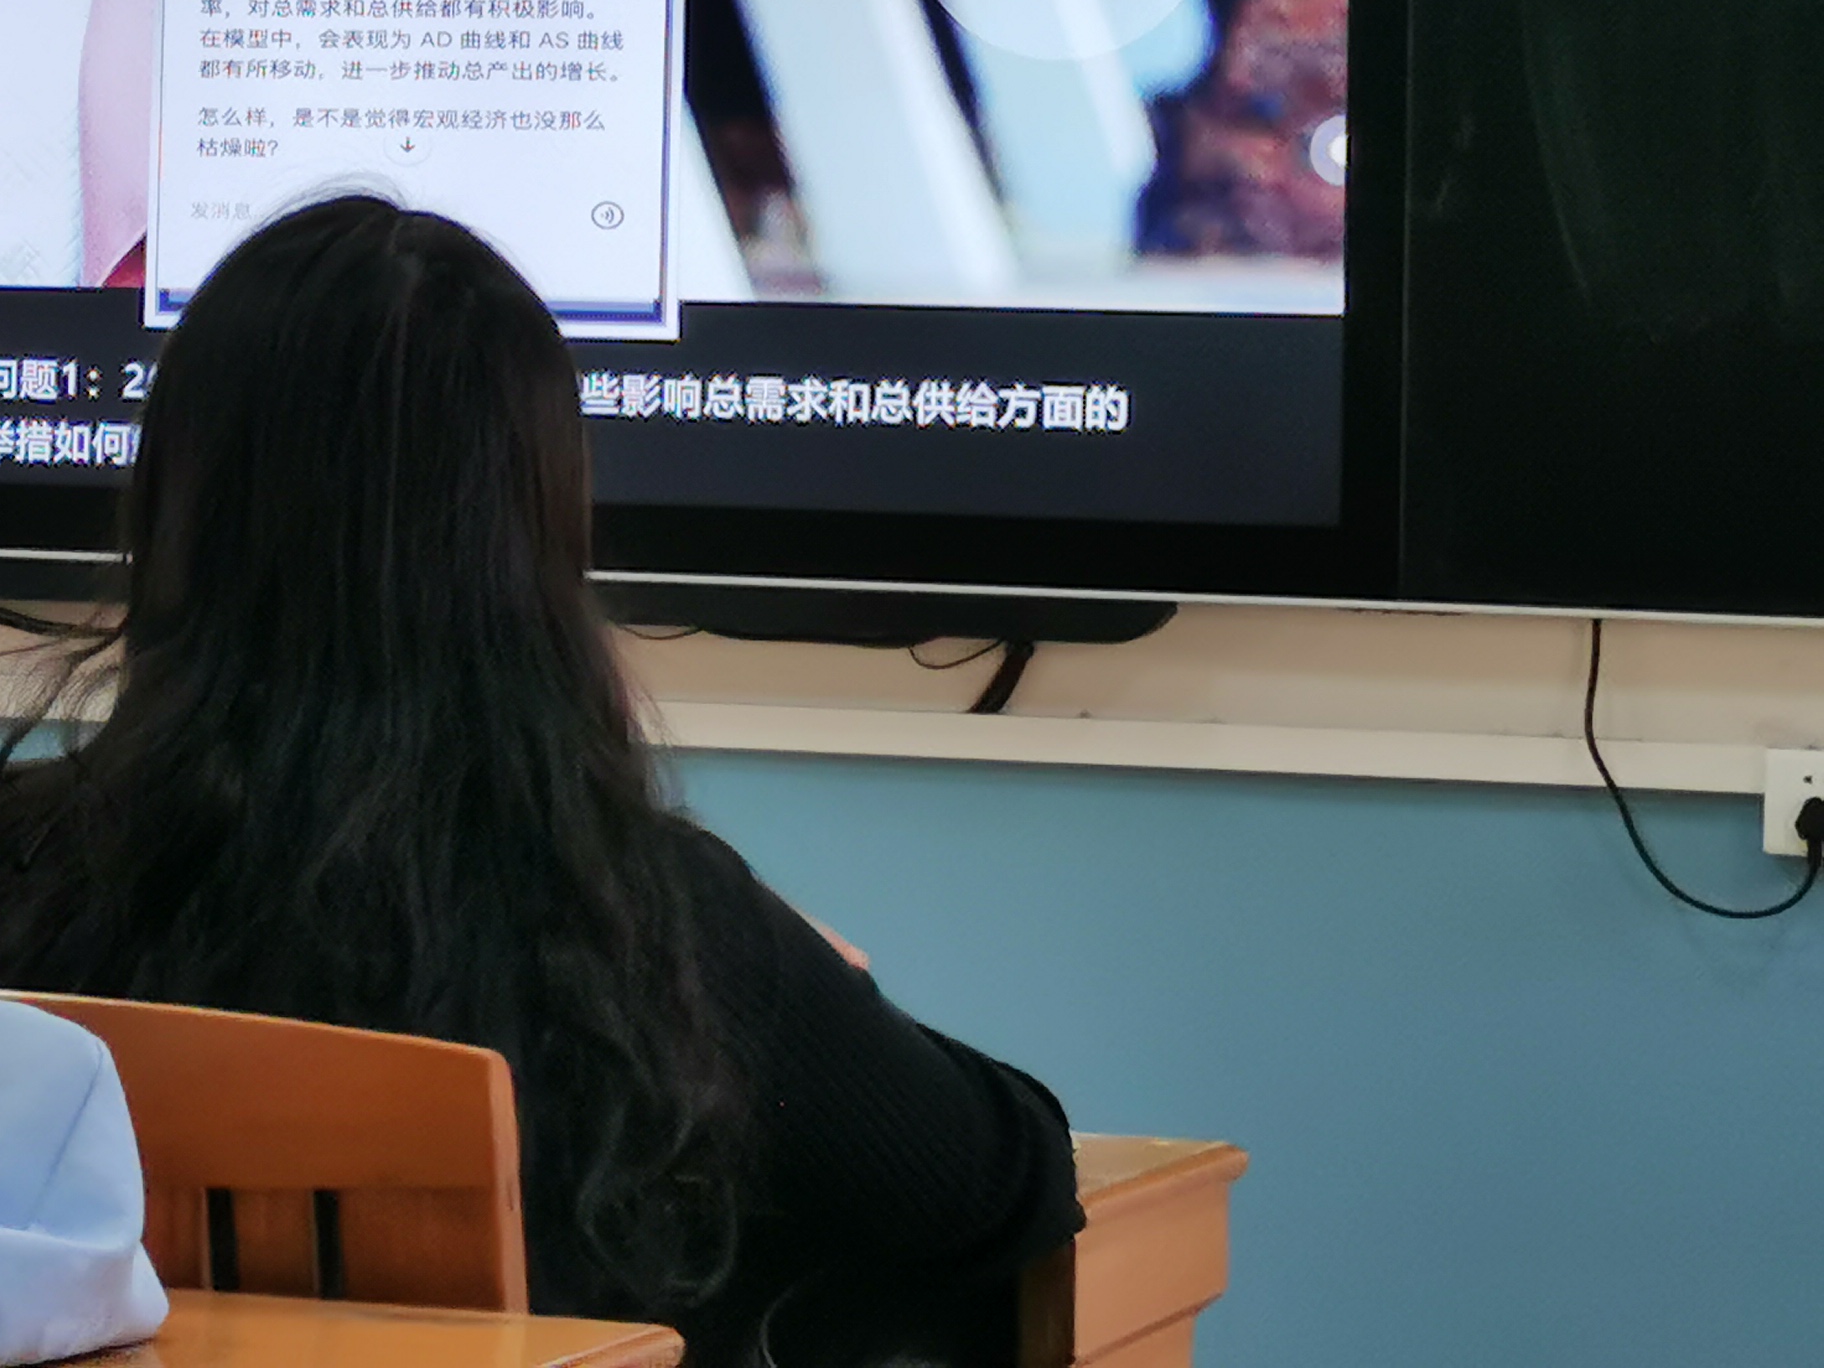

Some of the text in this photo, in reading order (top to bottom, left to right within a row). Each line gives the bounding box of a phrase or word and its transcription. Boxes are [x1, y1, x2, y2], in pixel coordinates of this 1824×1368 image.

[420, 30, 453, 48] AD
[460, 29, 531, 50] 曲线和
[538, 30, 570, 50] AS
[577, 30, 624, 51] 曲线
[196, 137, 279, 158] 枯燥啦？
